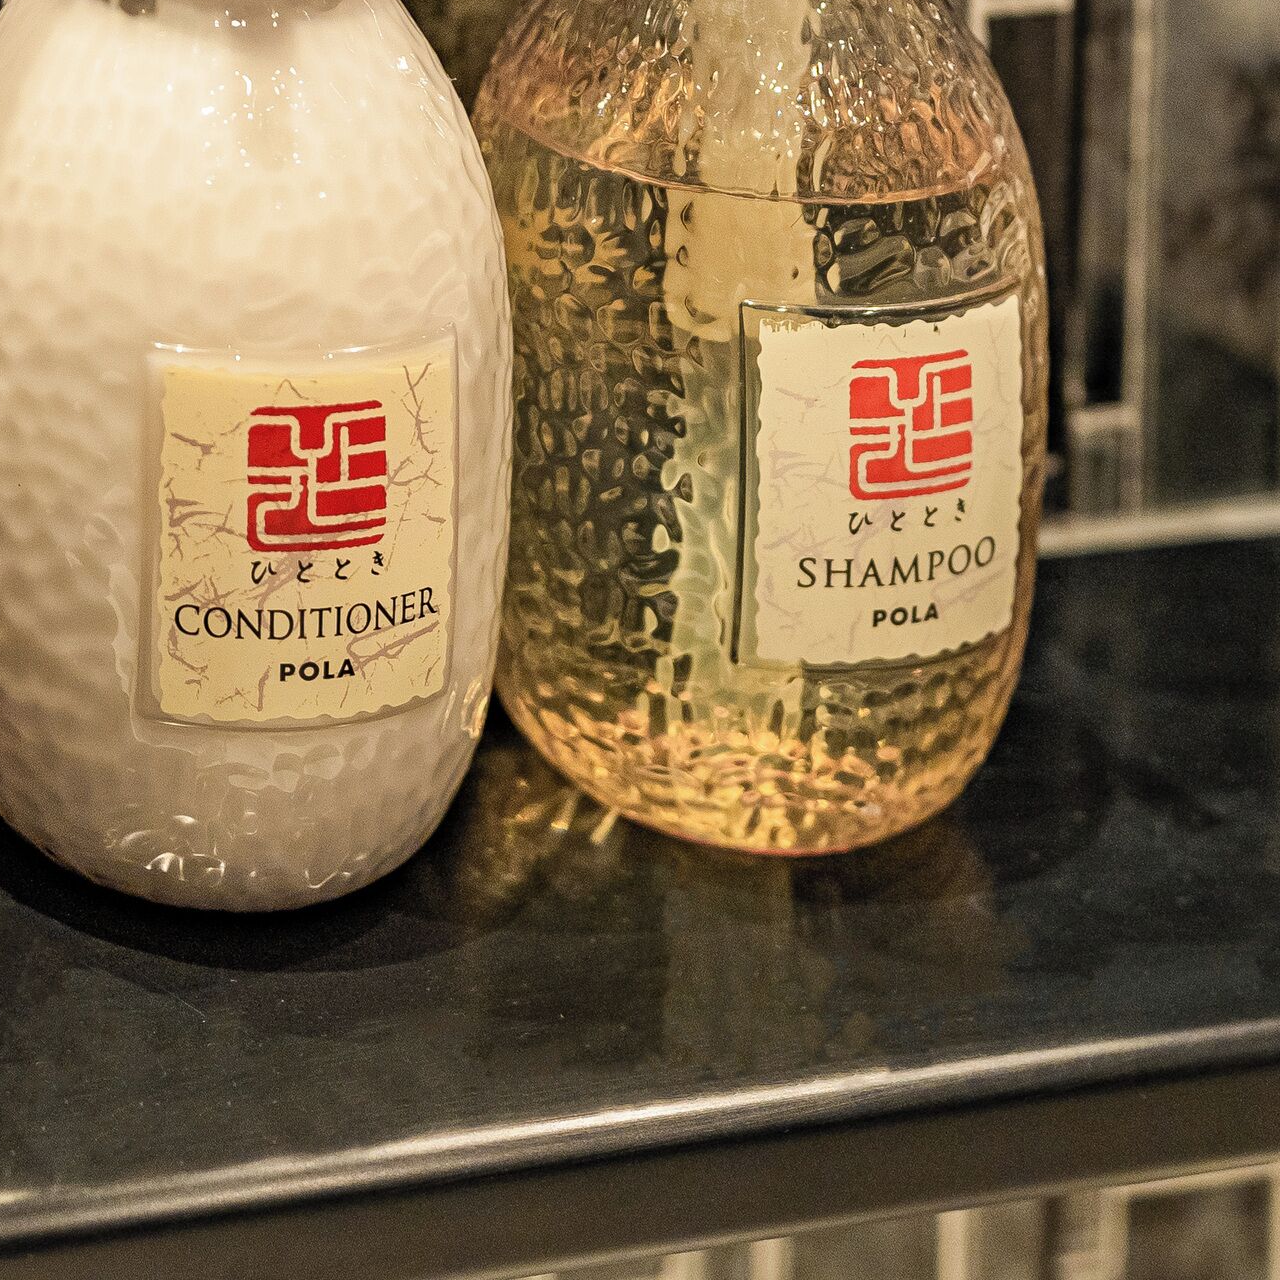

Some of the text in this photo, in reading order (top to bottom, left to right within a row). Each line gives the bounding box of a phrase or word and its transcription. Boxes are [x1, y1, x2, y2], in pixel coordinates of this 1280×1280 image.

[849, 498, 965, 534] ひととき
[251, 551, 384, 583] ひととき
[797, 536, 996, 588] SHAMPOO
[174, 587, 438, 639] CONDITIONER
[872, 603, 939, 627] POLA
[279, 659, 355, 681] POLA
